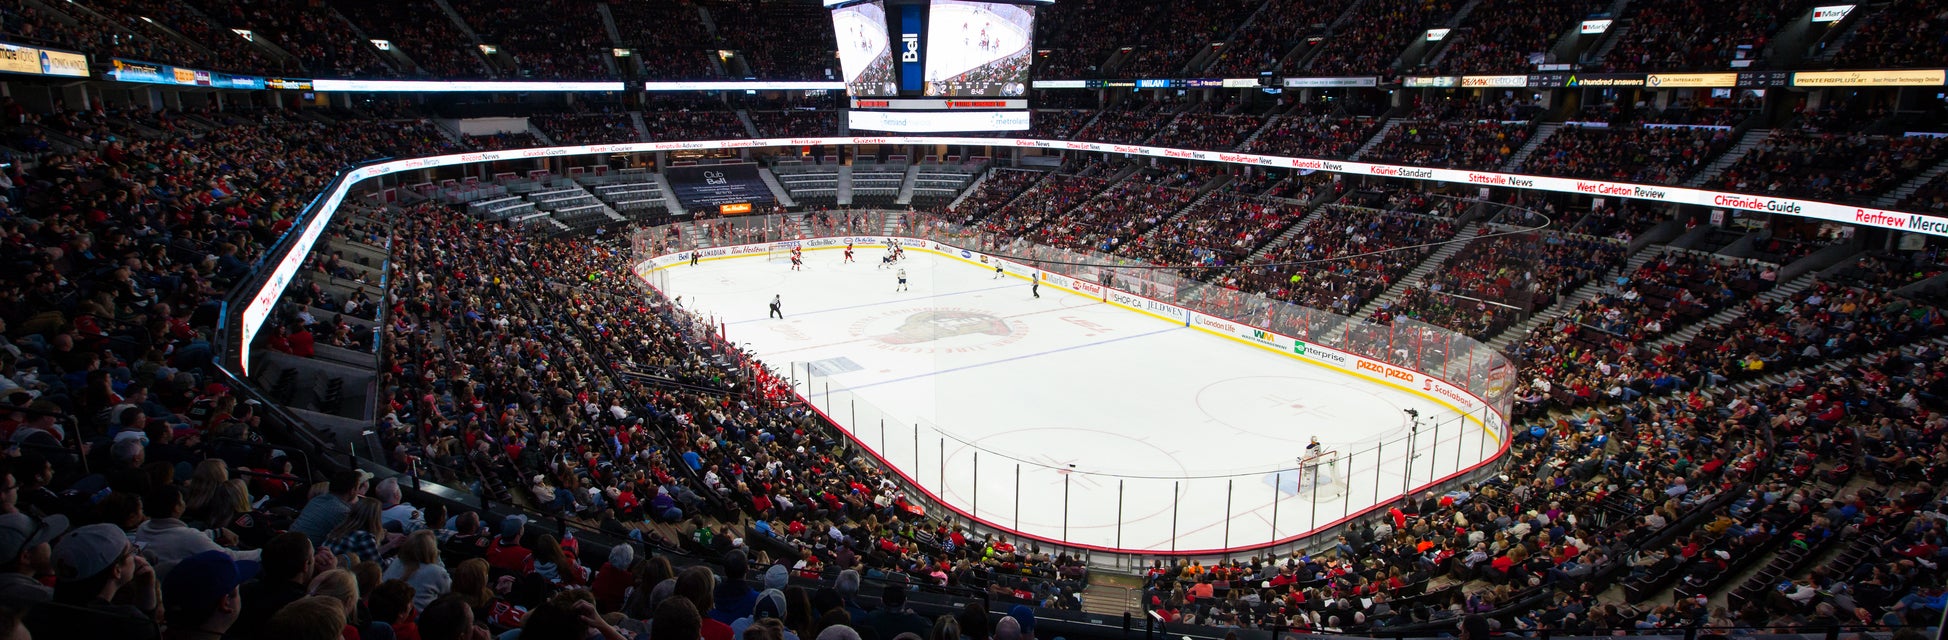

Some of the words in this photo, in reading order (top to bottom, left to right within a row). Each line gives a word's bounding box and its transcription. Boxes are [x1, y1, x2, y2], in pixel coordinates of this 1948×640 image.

[902, 33, 918, 63] Bell
[1462, 77, 1488, 86] RE/MAX
[1139, 147, 1150, 155] News
[1164, 149, 1180, 157] Ottawa
[1181, 150, 1192, 158] West
[1192, 151, 1205, 160] News
[1259, 156, 1273, 165] News
[1292, 159, 1322, 169] Manotick
[1322, 161, 1343, 171] News
[703, 171, 724, 179] Club
[1370, 165, 1433, 179] Kourier-Standard
[706, 177, 727, 185] Bell
[1468, 173, 1506, 185] Stittsville
[1508, 176, 1533, 187] News
[1576, 181, 1596, 193] West
[1599, 182, 1632, 196] Carleton
[1634, 187, 1665, 199] Review
[1714, 194, 1801, 214] Chronicle-Guide
[1855, 208, 1906, 228] Renfrew
[678, 252, 690, 261] Bell
[731, 246, 742, 255] Tim
[743, 245, 766, 254] Hortons
[1203, 317, 1225, 330] London
[1225, 324, 1236, 333] Life
[1253, 329, 1275, 342] WM
[1256, 338, 1287, 350] MANAGEMENT
[1295, 343, 1345, 363] enterprise
[1356, 359, 1384, 374] pizza
[1385, 367, 1414, 383] pizza
[1434, 384, 1473, 409] Scotiabank
